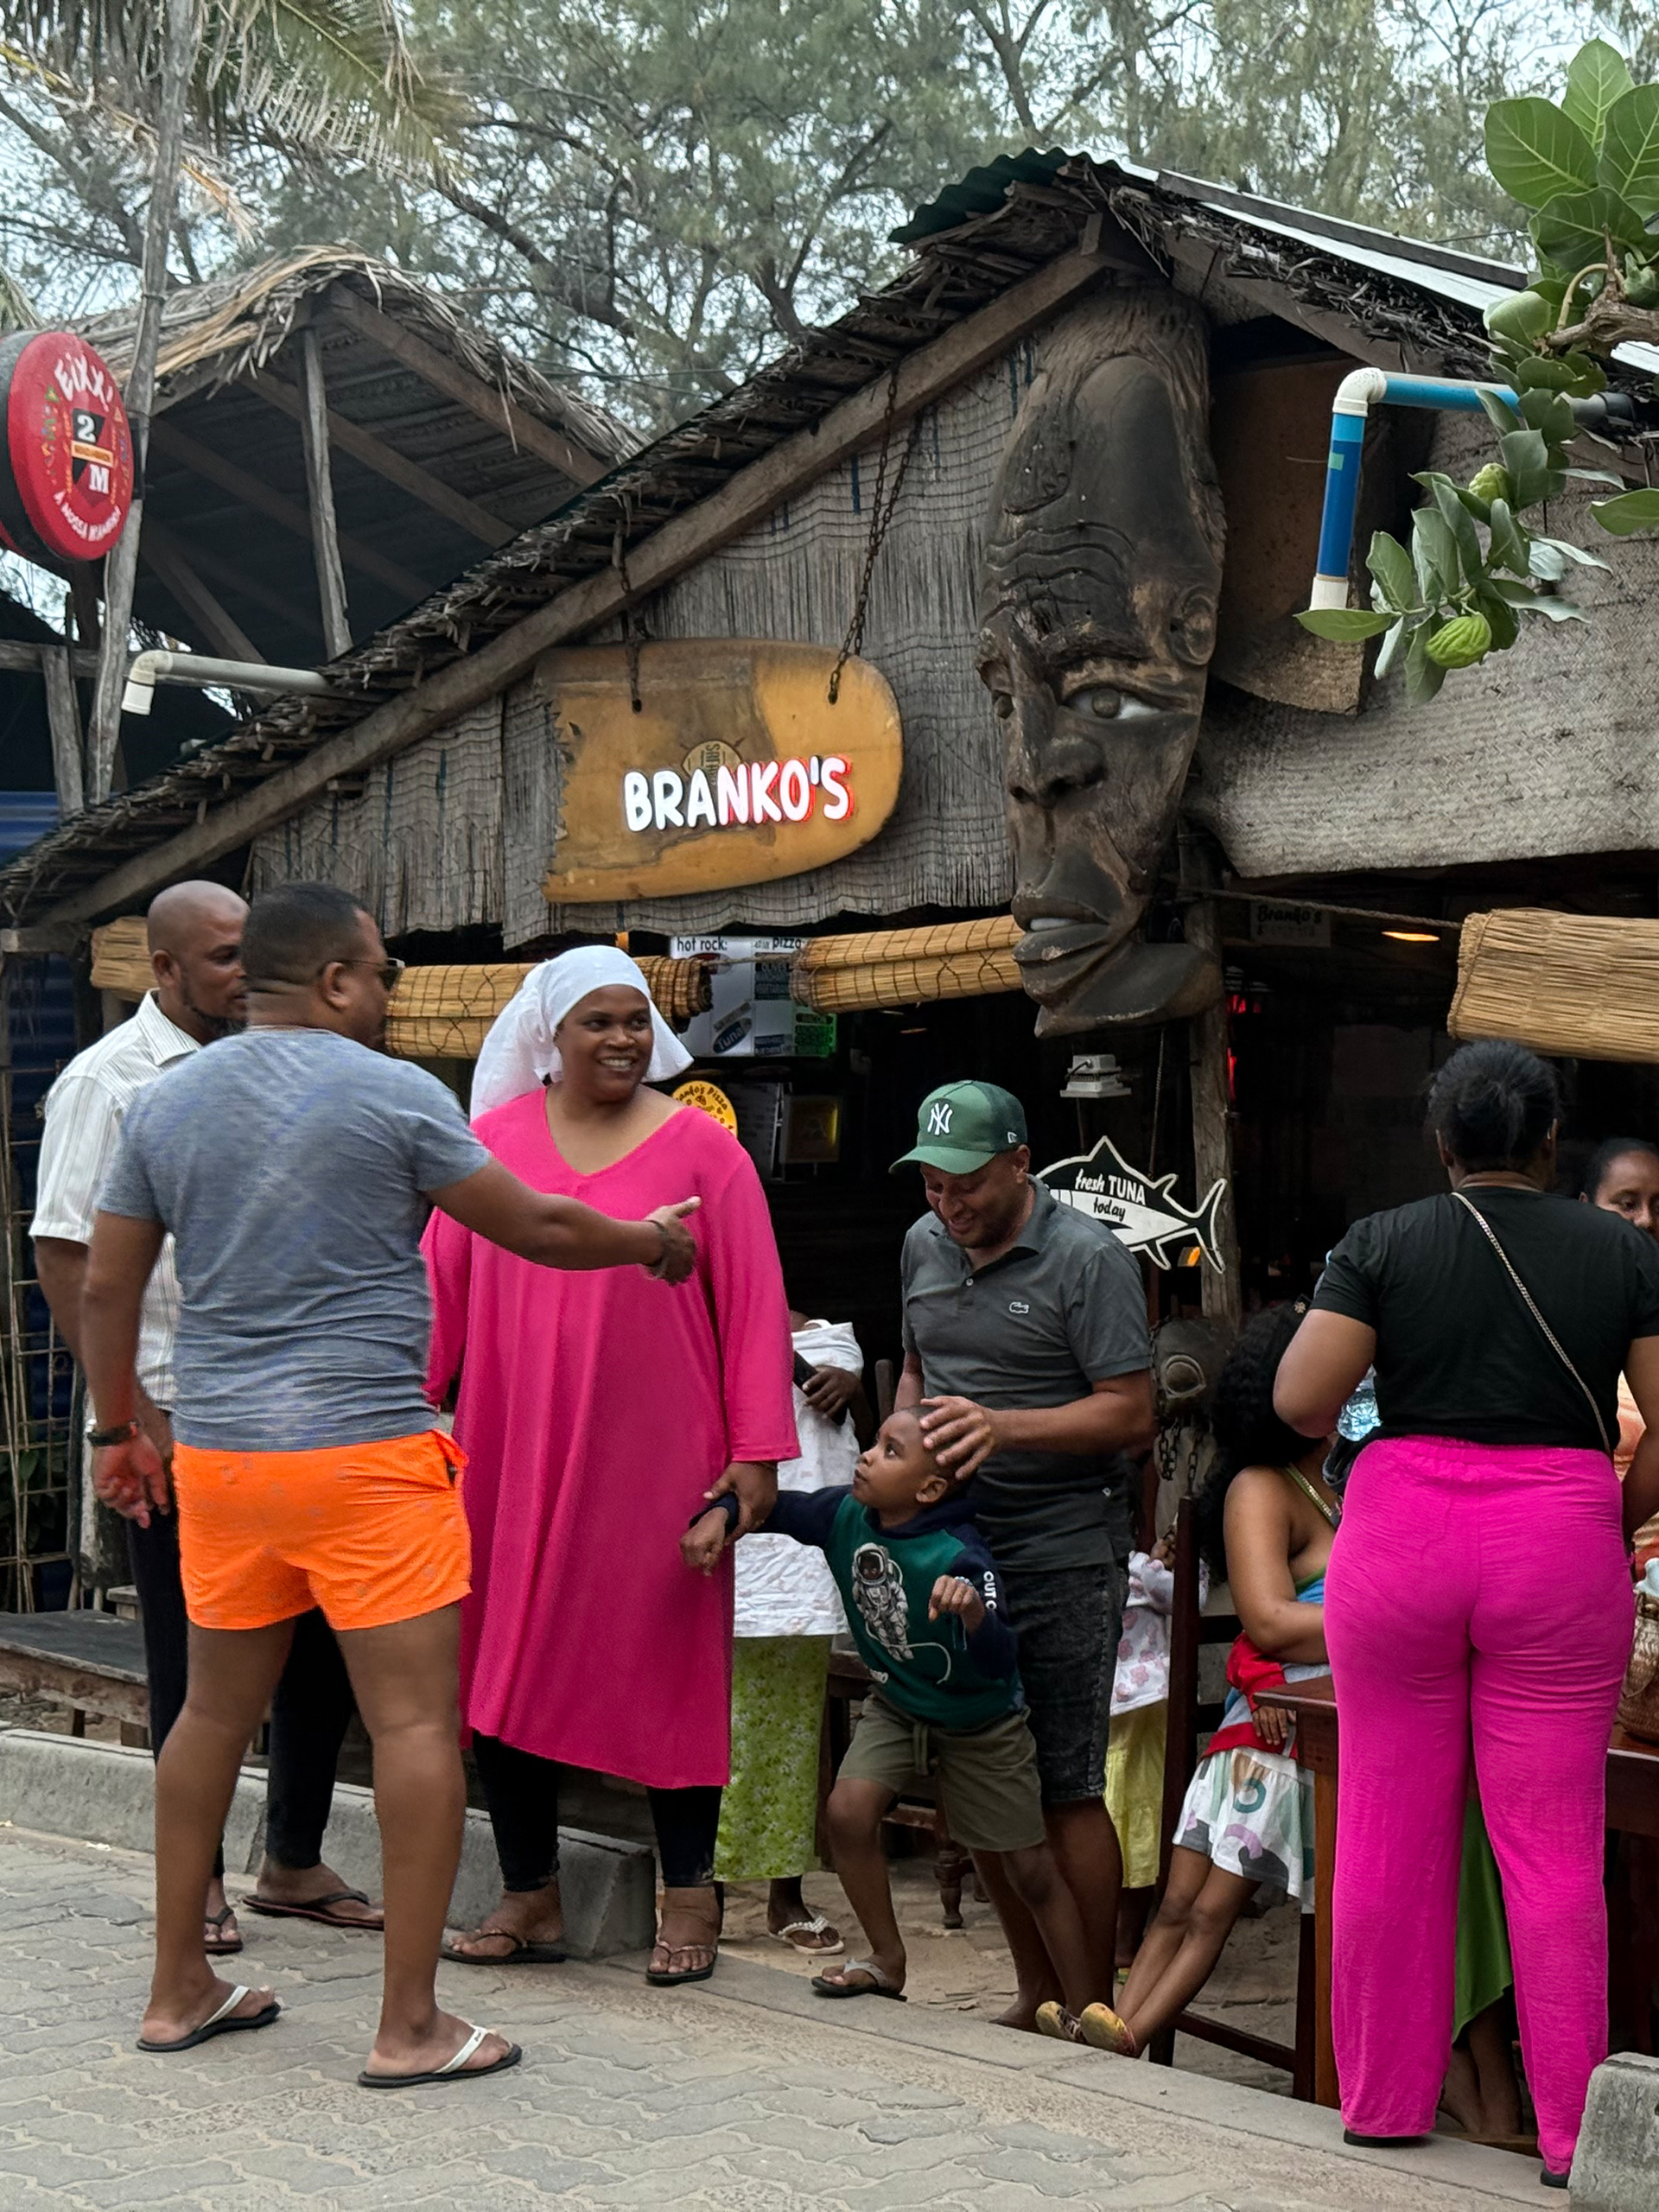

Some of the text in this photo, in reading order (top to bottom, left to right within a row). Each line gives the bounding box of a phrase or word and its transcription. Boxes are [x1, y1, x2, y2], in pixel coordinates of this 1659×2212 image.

[77, 414, 96, 442] 2
[88, 463, 110, 495] M
[624, 755, 852, 832] BRANKO'S
[677, 937, 696, 951] hot
[927, 1103, 953, 1135] NY
[1074, 1167, 1147, 1205] fresh TUNA
[1093, 1197, 1126, 1222] today
[983, 1571, 997, 1599] OUT
